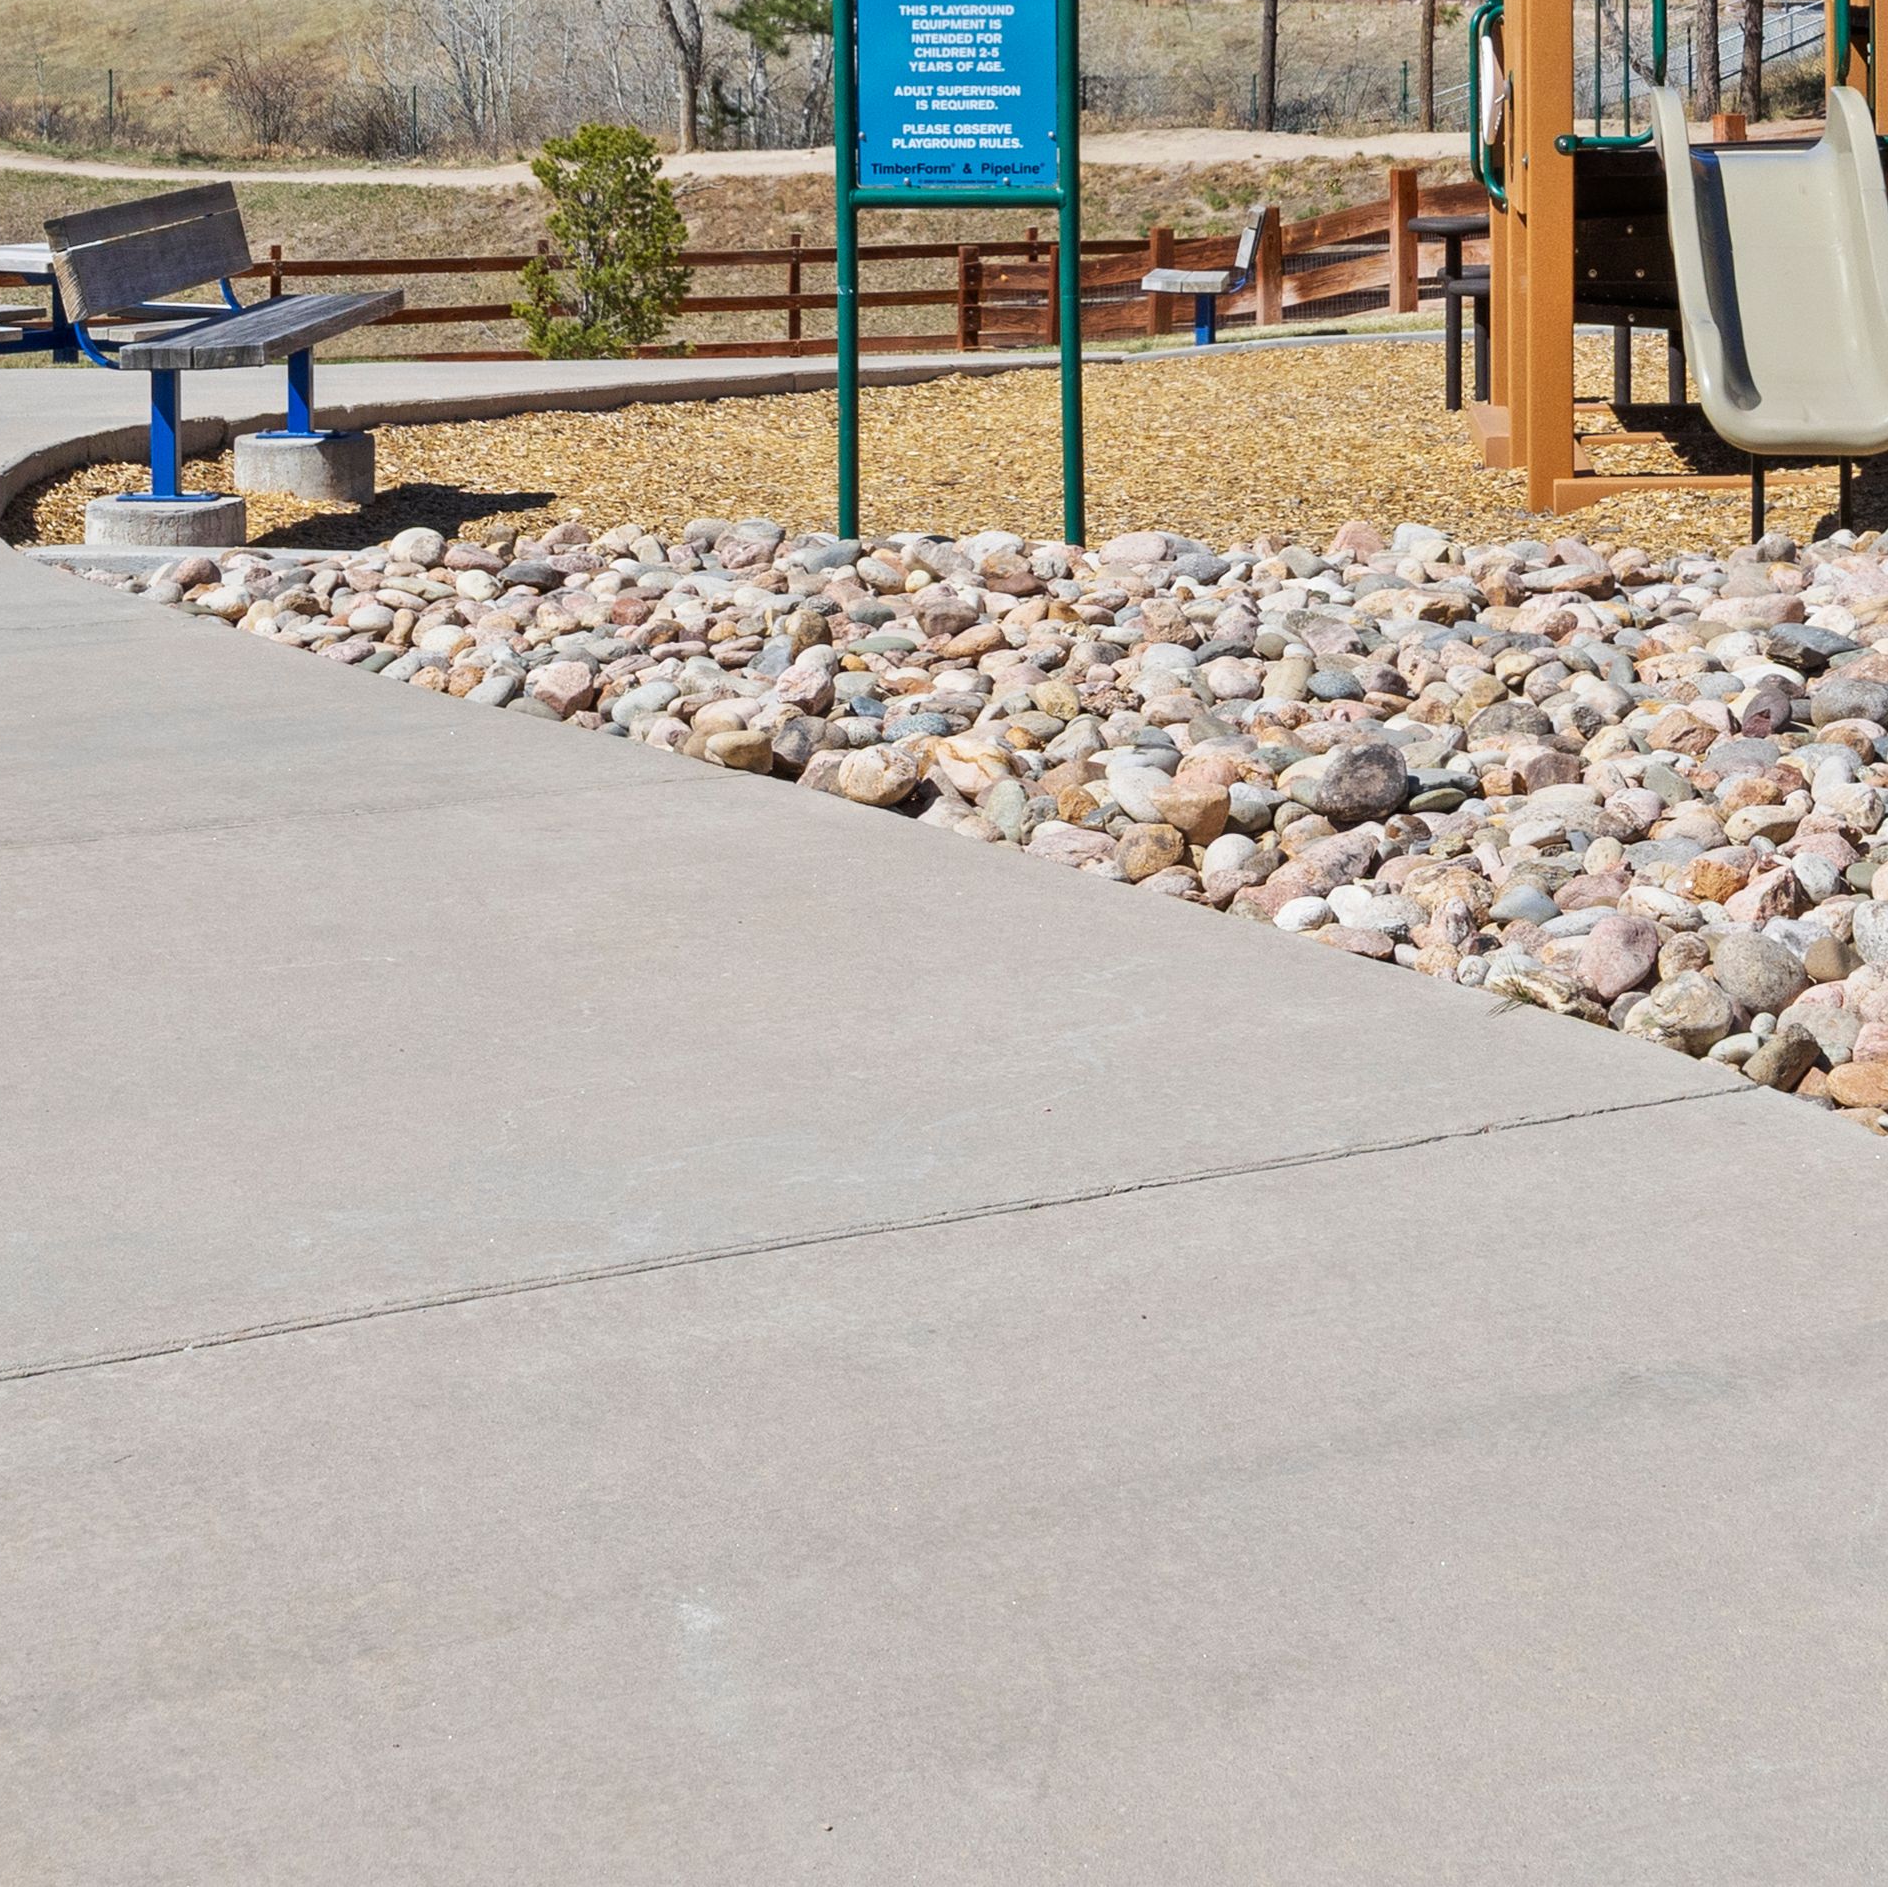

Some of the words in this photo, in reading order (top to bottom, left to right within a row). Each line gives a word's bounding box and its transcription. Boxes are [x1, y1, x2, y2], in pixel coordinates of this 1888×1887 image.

[899, 5, 928, 16] THIS
[930, 5, 1014, 16] PLAYGROUND
[912, 19, 986, 30] EQUIPMENT
[989, 19, 1002, 30] IS
[912, 33, 974, 44] INTENDED
[976, 33, 1002, 44] FOR
[914, 47, 976, 58] CHILDREN
[909, 61, 953, 72] YEARS
[956, 61, 974, 72] OF
[976, 61, 1005, 72] AGE.
[894, 86, 933, 96] ADULT
[937, 85, 1021, 96] SUPERVISION
[916, 100, 928, 110] IS
[931, 99, 998, 110] REQUIRED.
[903, 124, 951, 135] PLEASE
[953, 124, 1012, 134] OBSERVE
[892, 138, 976, 149] PLAYGROUND
[979, 138, 1023, 148] RULES.
[962, 163, 972, 174] &
